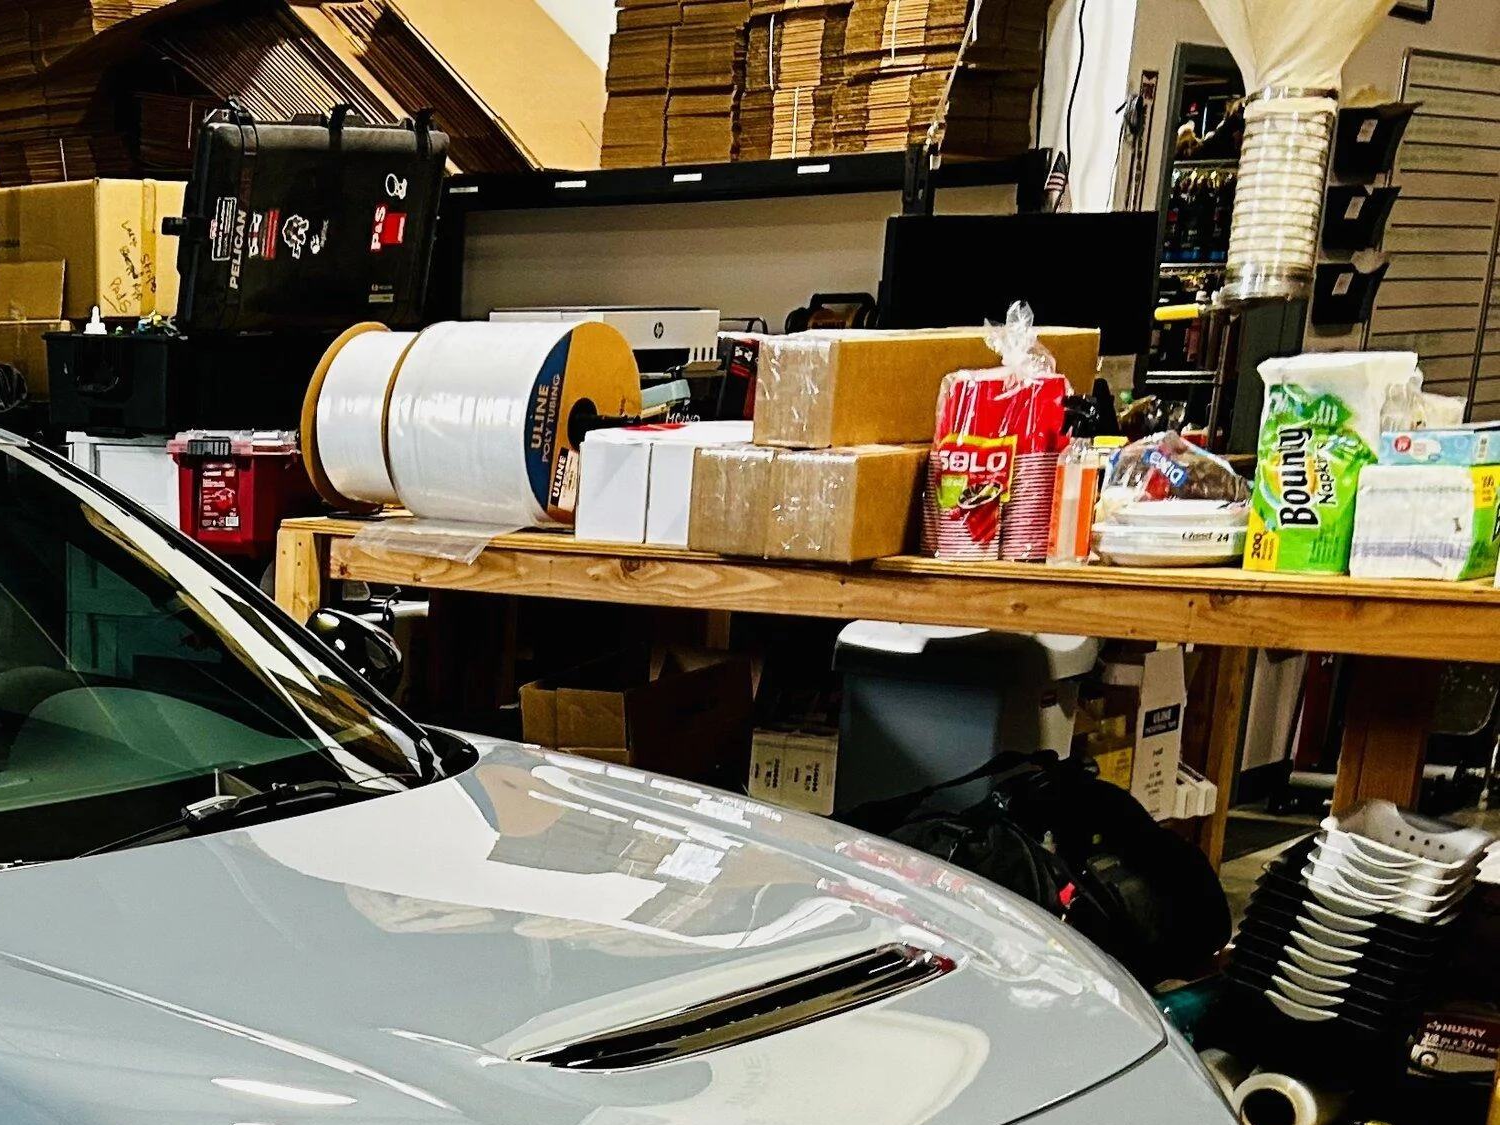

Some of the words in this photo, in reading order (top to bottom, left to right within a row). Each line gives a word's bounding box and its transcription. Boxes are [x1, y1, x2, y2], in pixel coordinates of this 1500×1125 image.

[229, 209, 248, 290] PELICAN
[530, 383, 550, 449] ULINE
[546, 373, 561, 424] TUBING
[541, 426, 552, 463] POLY
[938, 449, 1008, 473] SOLO
[552, 455, 567, 498] ULINE
[1278, 427, 1319, 527] Bounty
